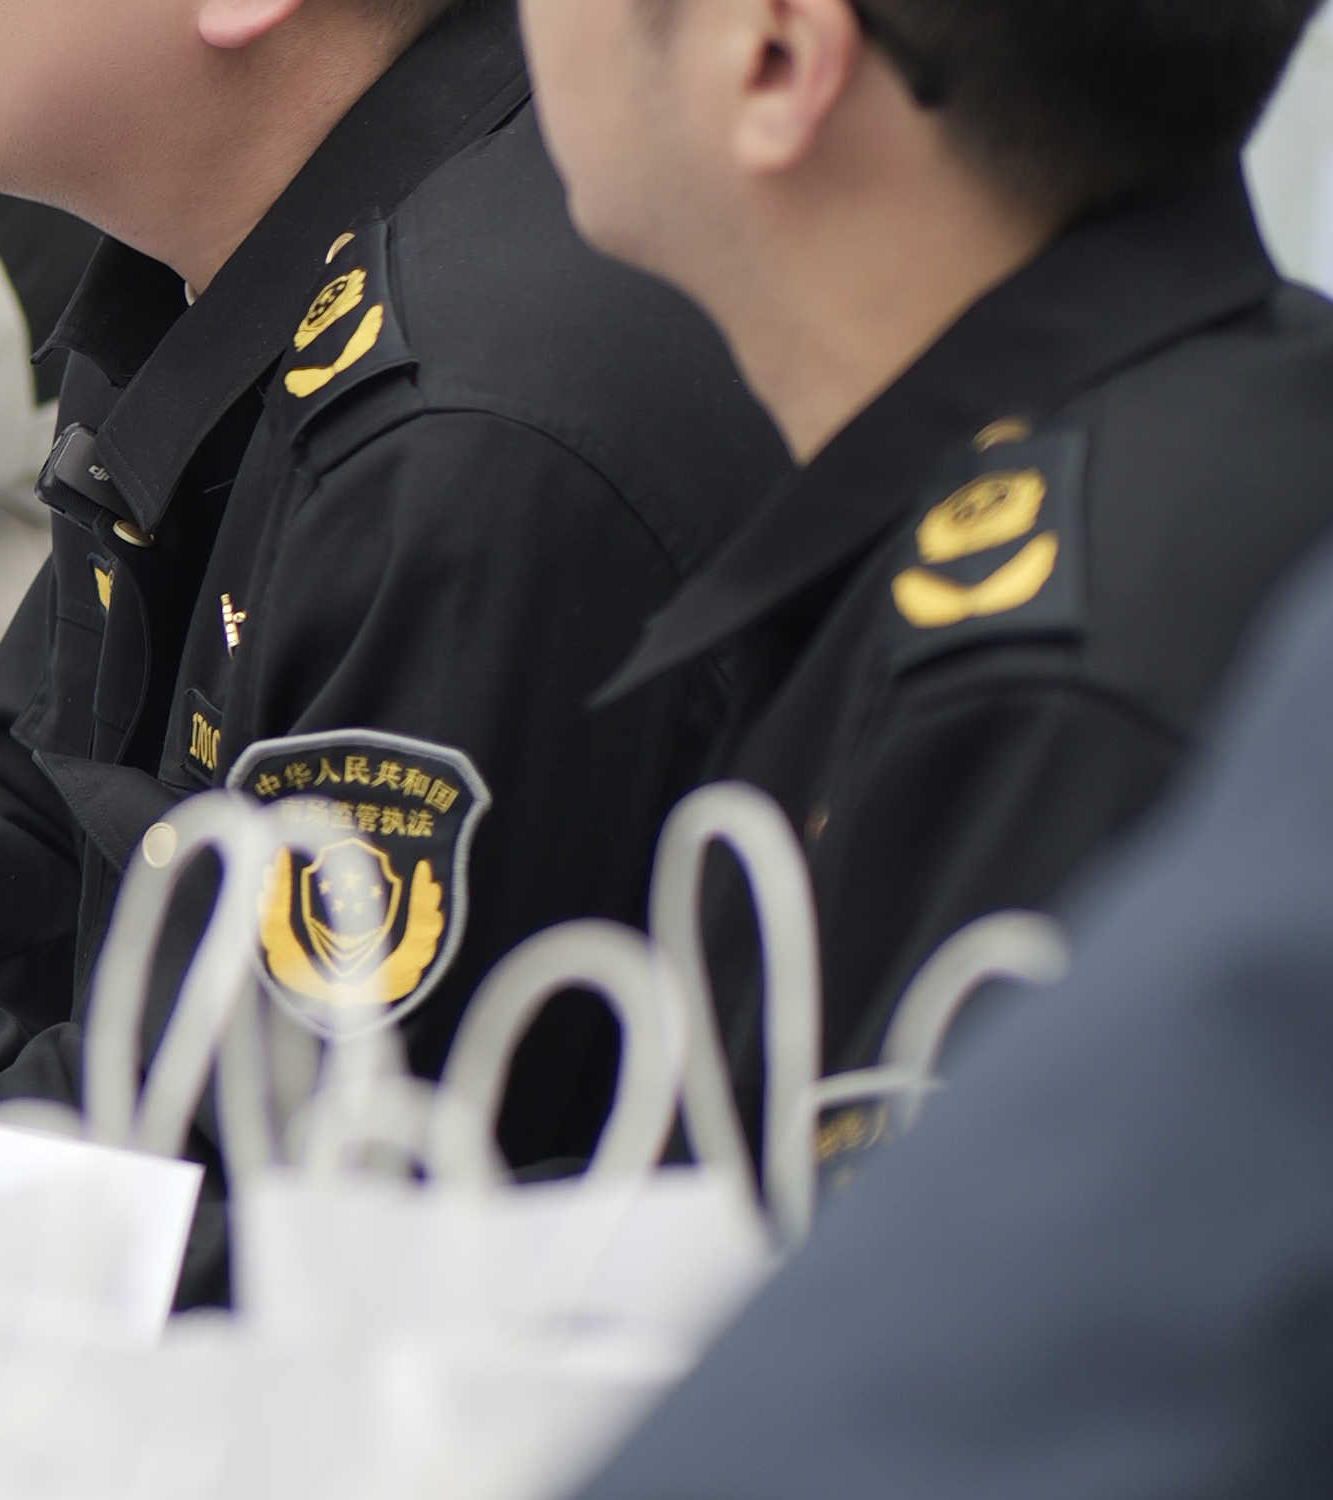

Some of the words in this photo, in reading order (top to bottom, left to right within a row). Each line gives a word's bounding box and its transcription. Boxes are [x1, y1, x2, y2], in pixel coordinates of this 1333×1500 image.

[254, 755, 459, 815] 中华人民共和国
[281, 799, 434, 838] 监管执法
